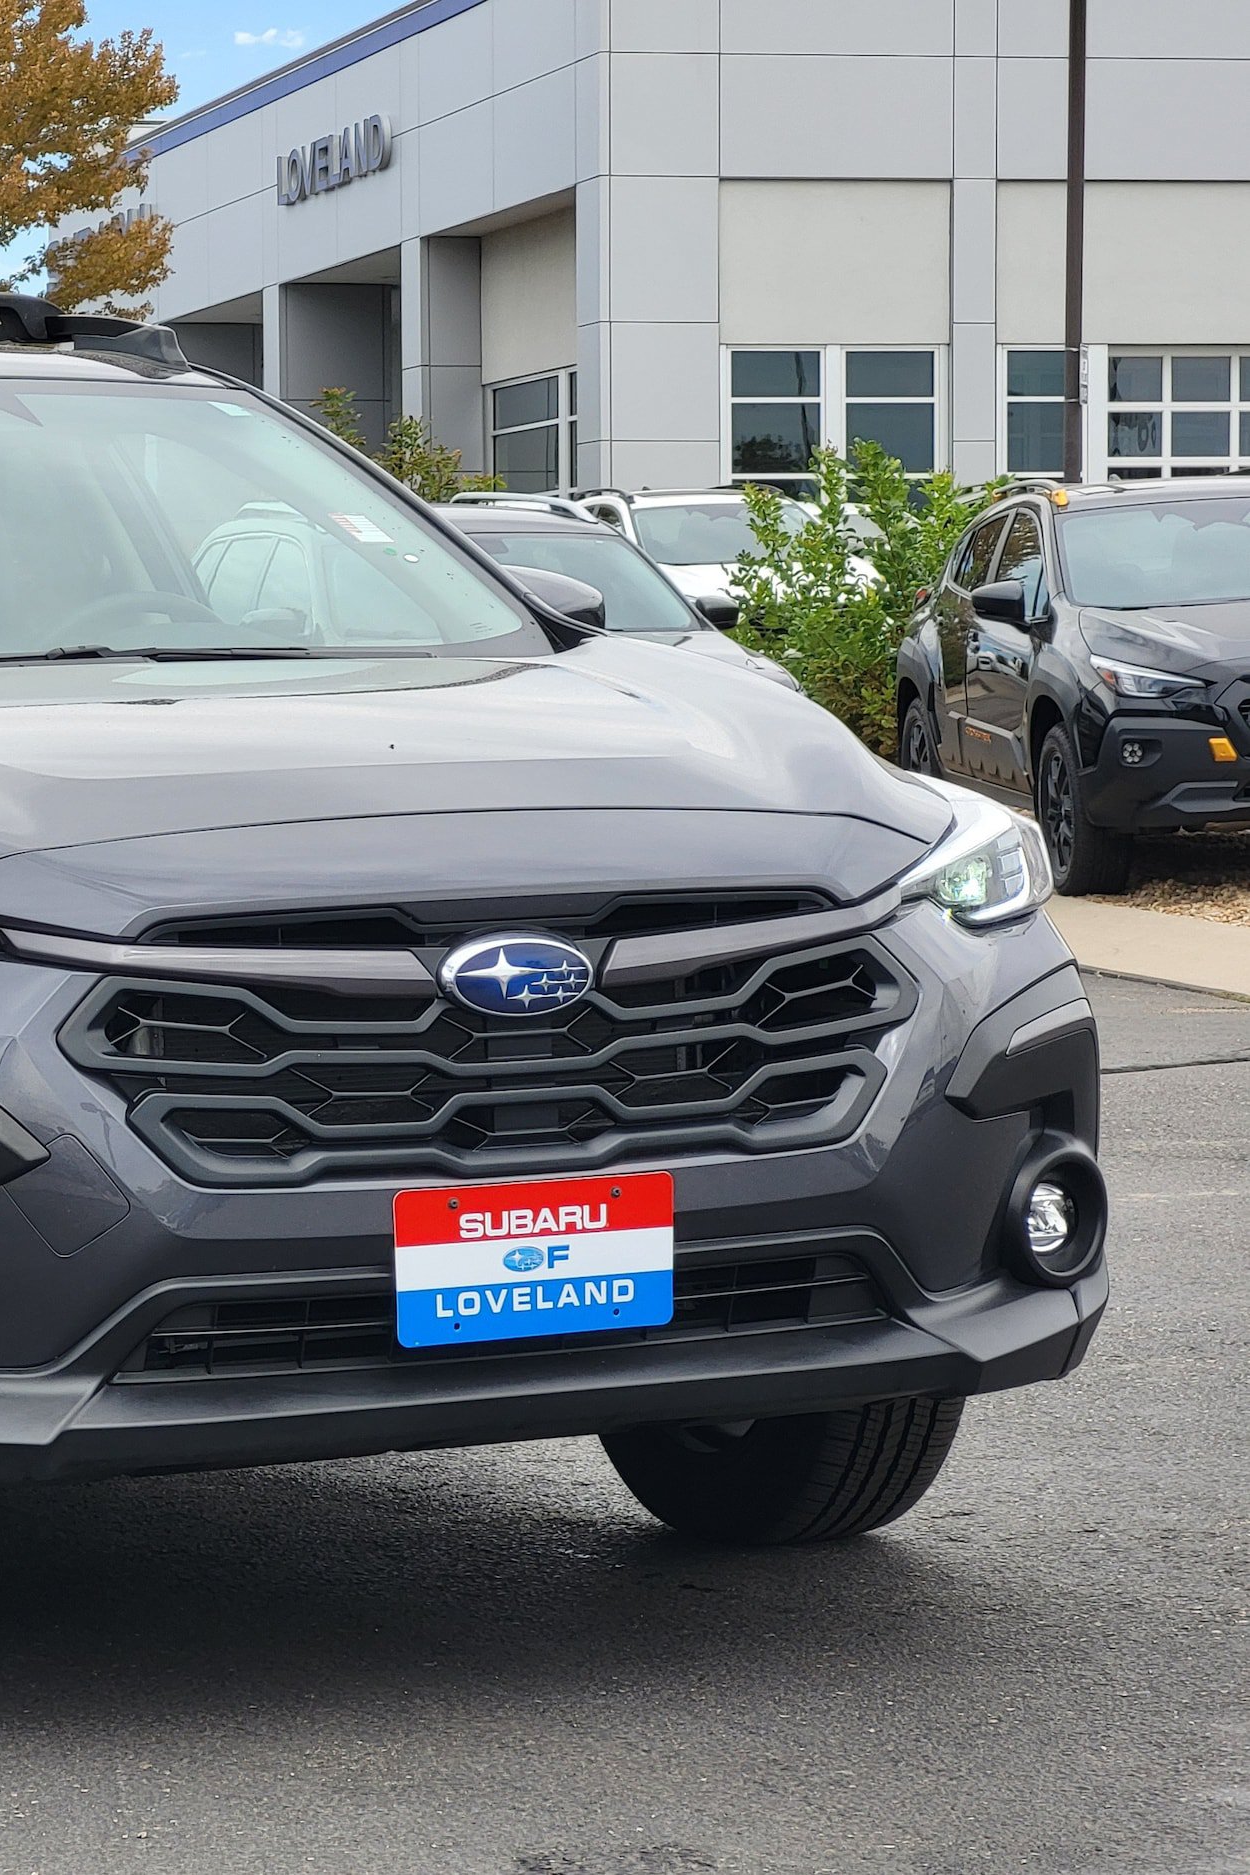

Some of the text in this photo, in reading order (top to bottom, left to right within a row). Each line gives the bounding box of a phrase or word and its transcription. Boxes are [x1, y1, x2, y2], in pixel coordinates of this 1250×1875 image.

[276, 113, 392, 206] LOVELAND
[458, 1203, 608, 1239] SUBARU
[435, 1278, 636, 1319] LOVELAND
